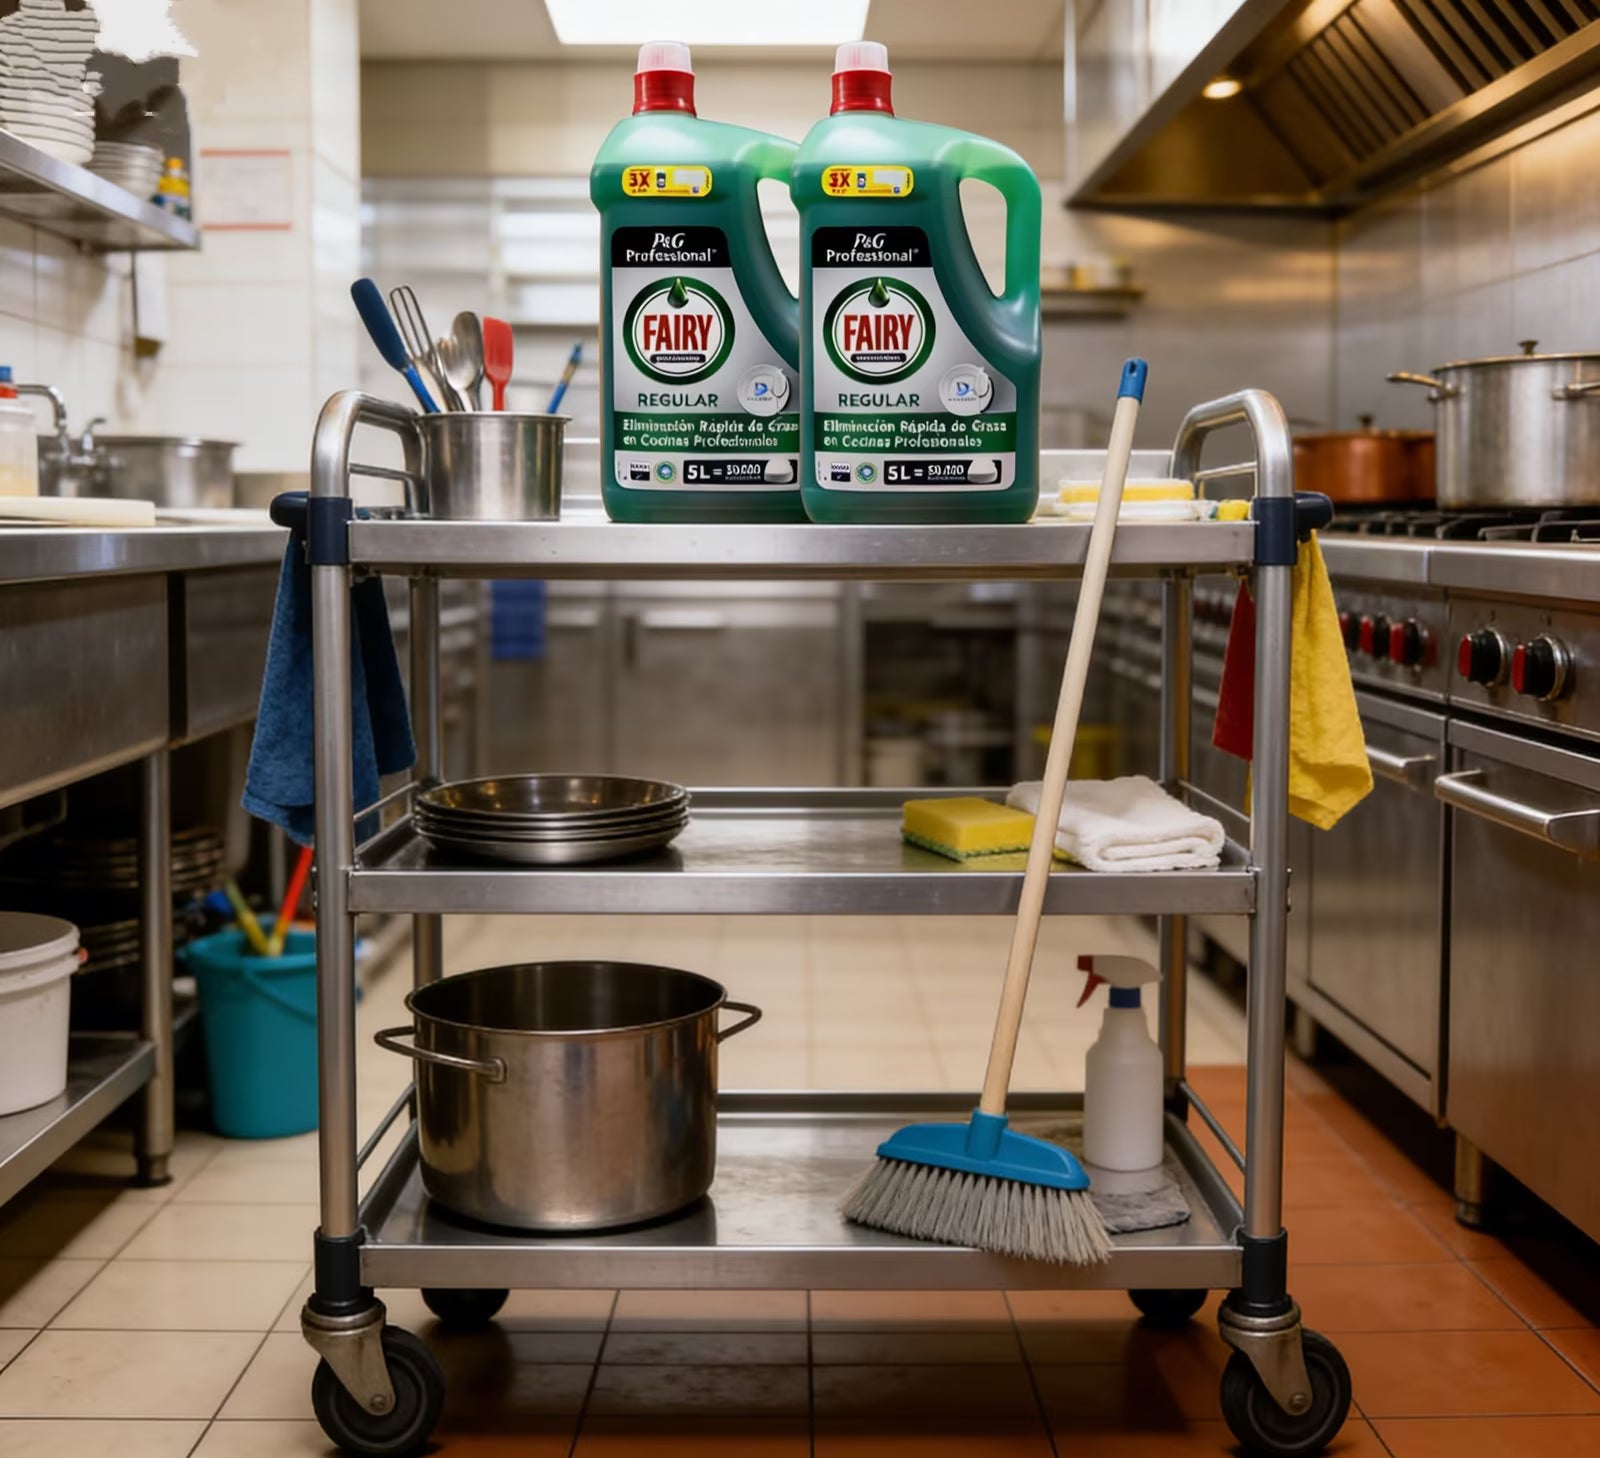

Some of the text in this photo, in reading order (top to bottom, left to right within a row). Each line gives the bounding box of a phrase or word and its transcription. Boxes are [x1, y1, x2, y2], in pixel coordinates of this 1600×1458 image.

[652, 232, 686, 249] P&G
[853, 232, 887, 249] P&G
[643, 314, 714, 352] FAIRY
[843, 314, 915, 352] FAIRY
[638, 393, 719, 408] REGULAR
[838, 393, 920, 408] REGULAR
